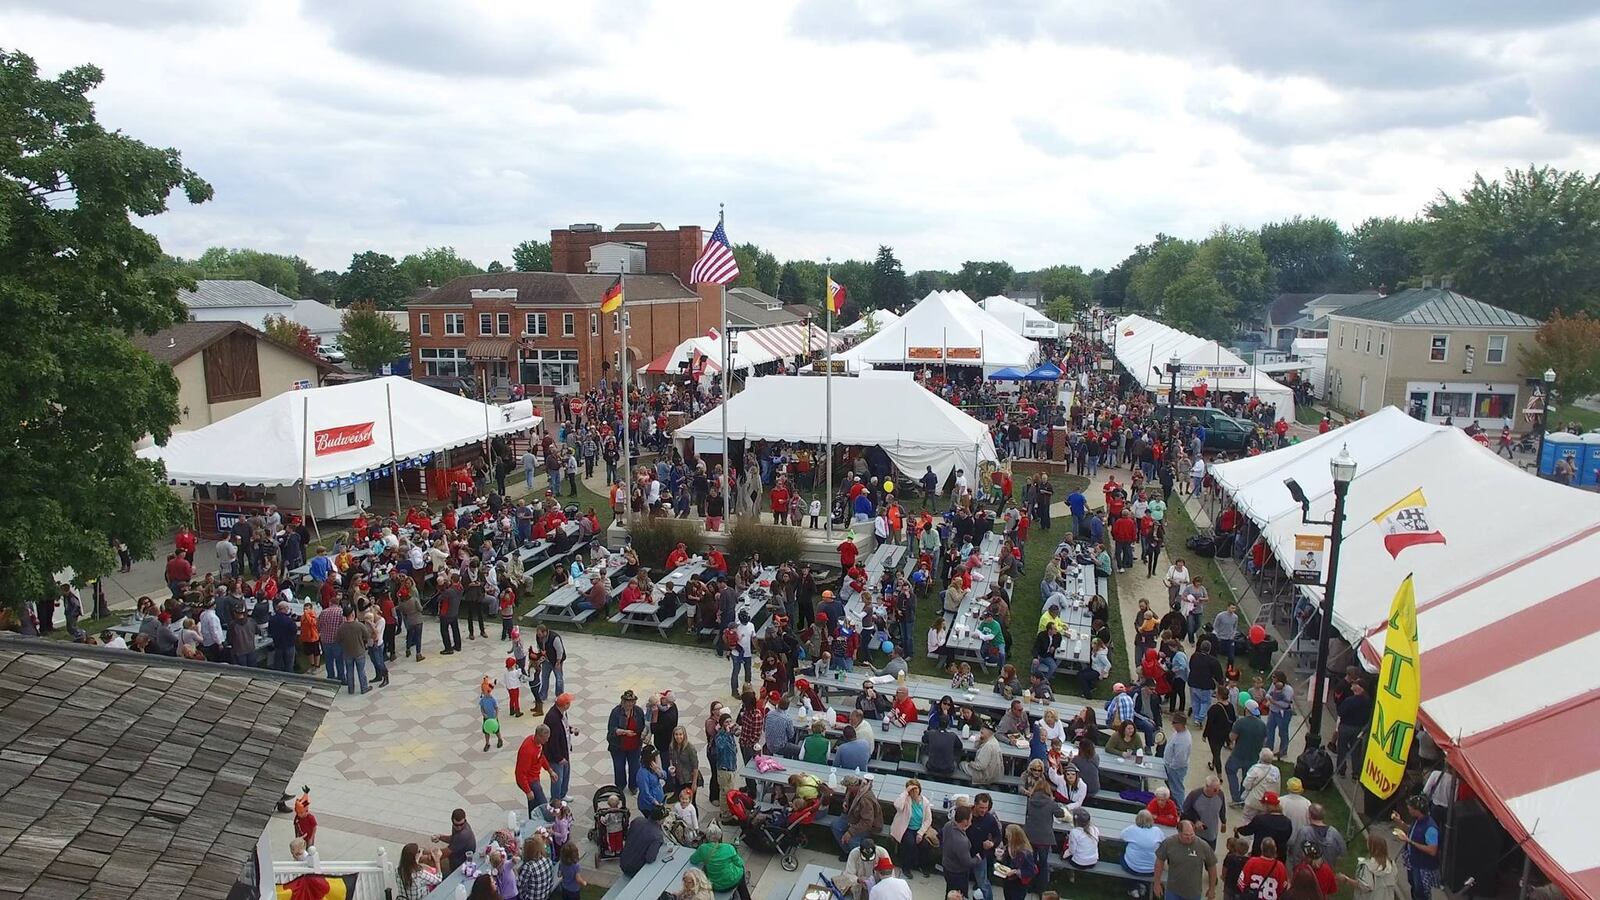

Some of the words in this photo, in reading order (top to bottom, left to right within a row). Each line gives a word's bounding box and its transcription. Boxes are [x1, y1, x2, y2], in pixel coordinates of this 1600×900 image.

[570, 402, 583, 410] STOP
[220, 516, 240, 528] BU
[1250, 874, 1278, 900] 28
